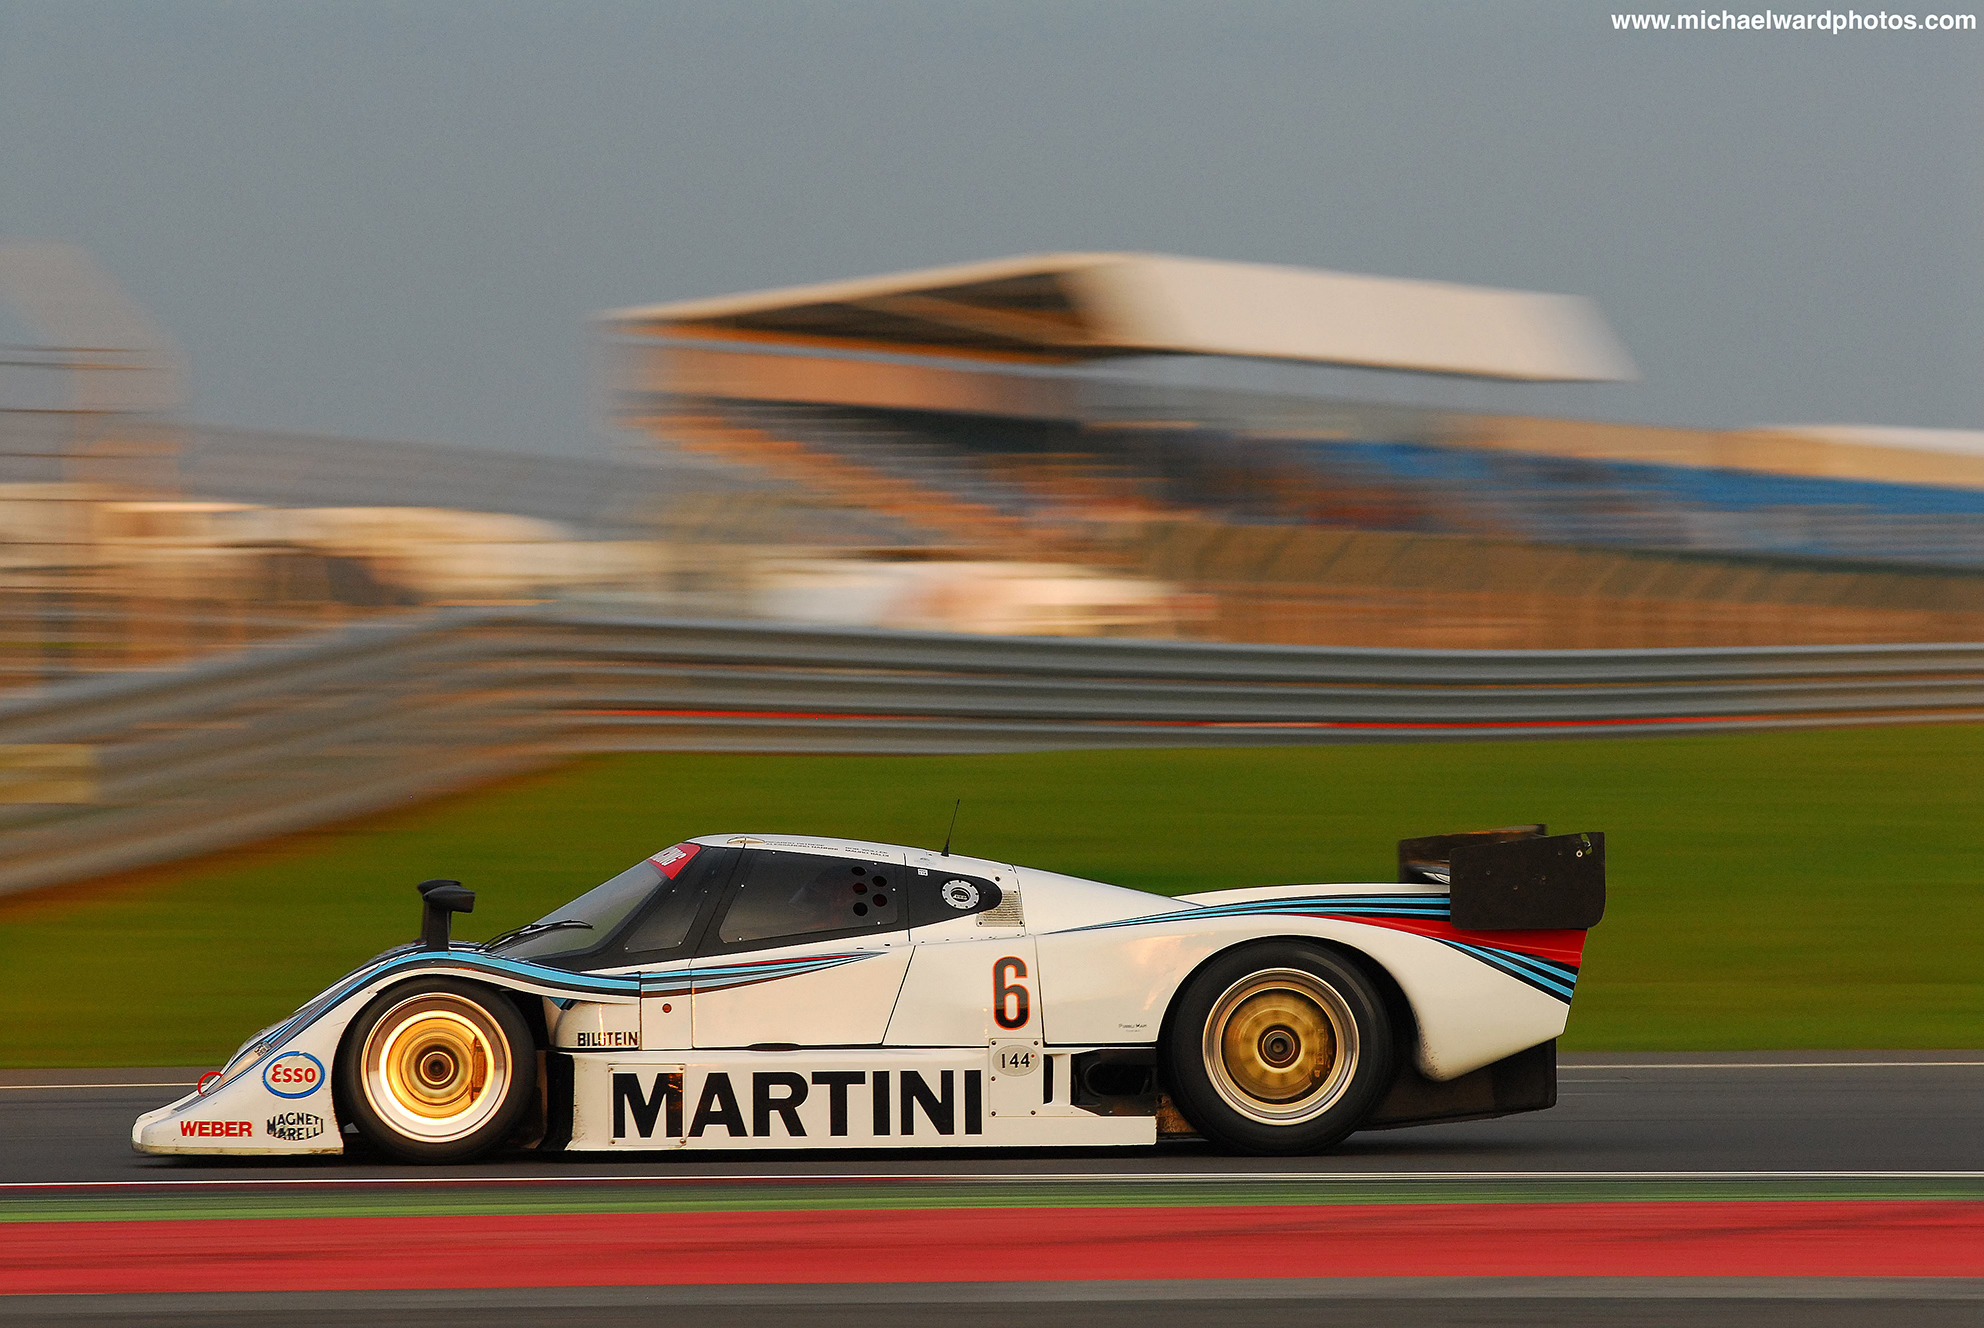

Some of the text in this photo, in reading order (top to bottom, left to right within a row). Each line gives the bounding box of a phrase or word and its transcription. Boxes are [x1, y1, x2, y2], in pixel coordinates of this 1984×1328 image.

[993, 956, 1031, 1031] 6
[577, 1031, 638, 1047] BILSTEIN
[1001, 1052, 1030, 1069] 144
[612, 1069, 983, 1138] MARTINI
[180, 1120, 253, 1137] WEBER
